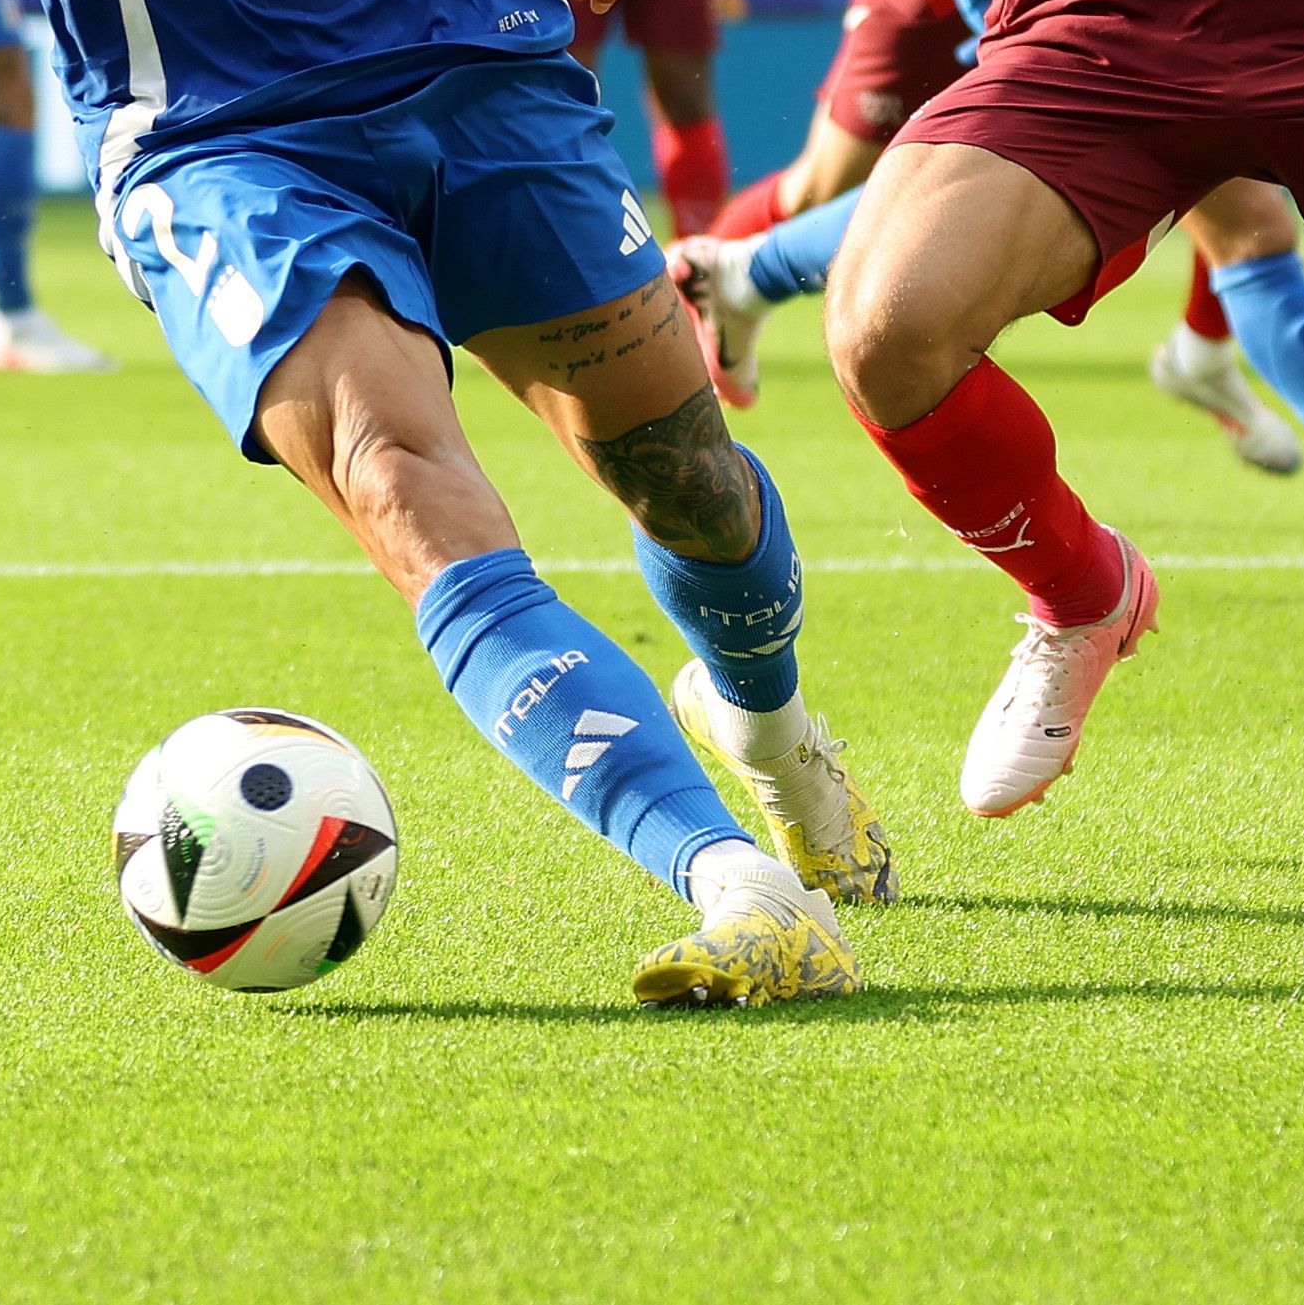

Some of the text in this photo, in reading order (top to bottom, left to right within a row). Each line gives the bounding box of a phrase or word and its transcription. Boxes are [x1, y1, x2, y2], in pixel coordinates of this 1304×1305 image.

[121, 182, 218, 297] 2
[700, 551, 800, 627] ITALIA
[494, 649, 590, 749] ITALIA
